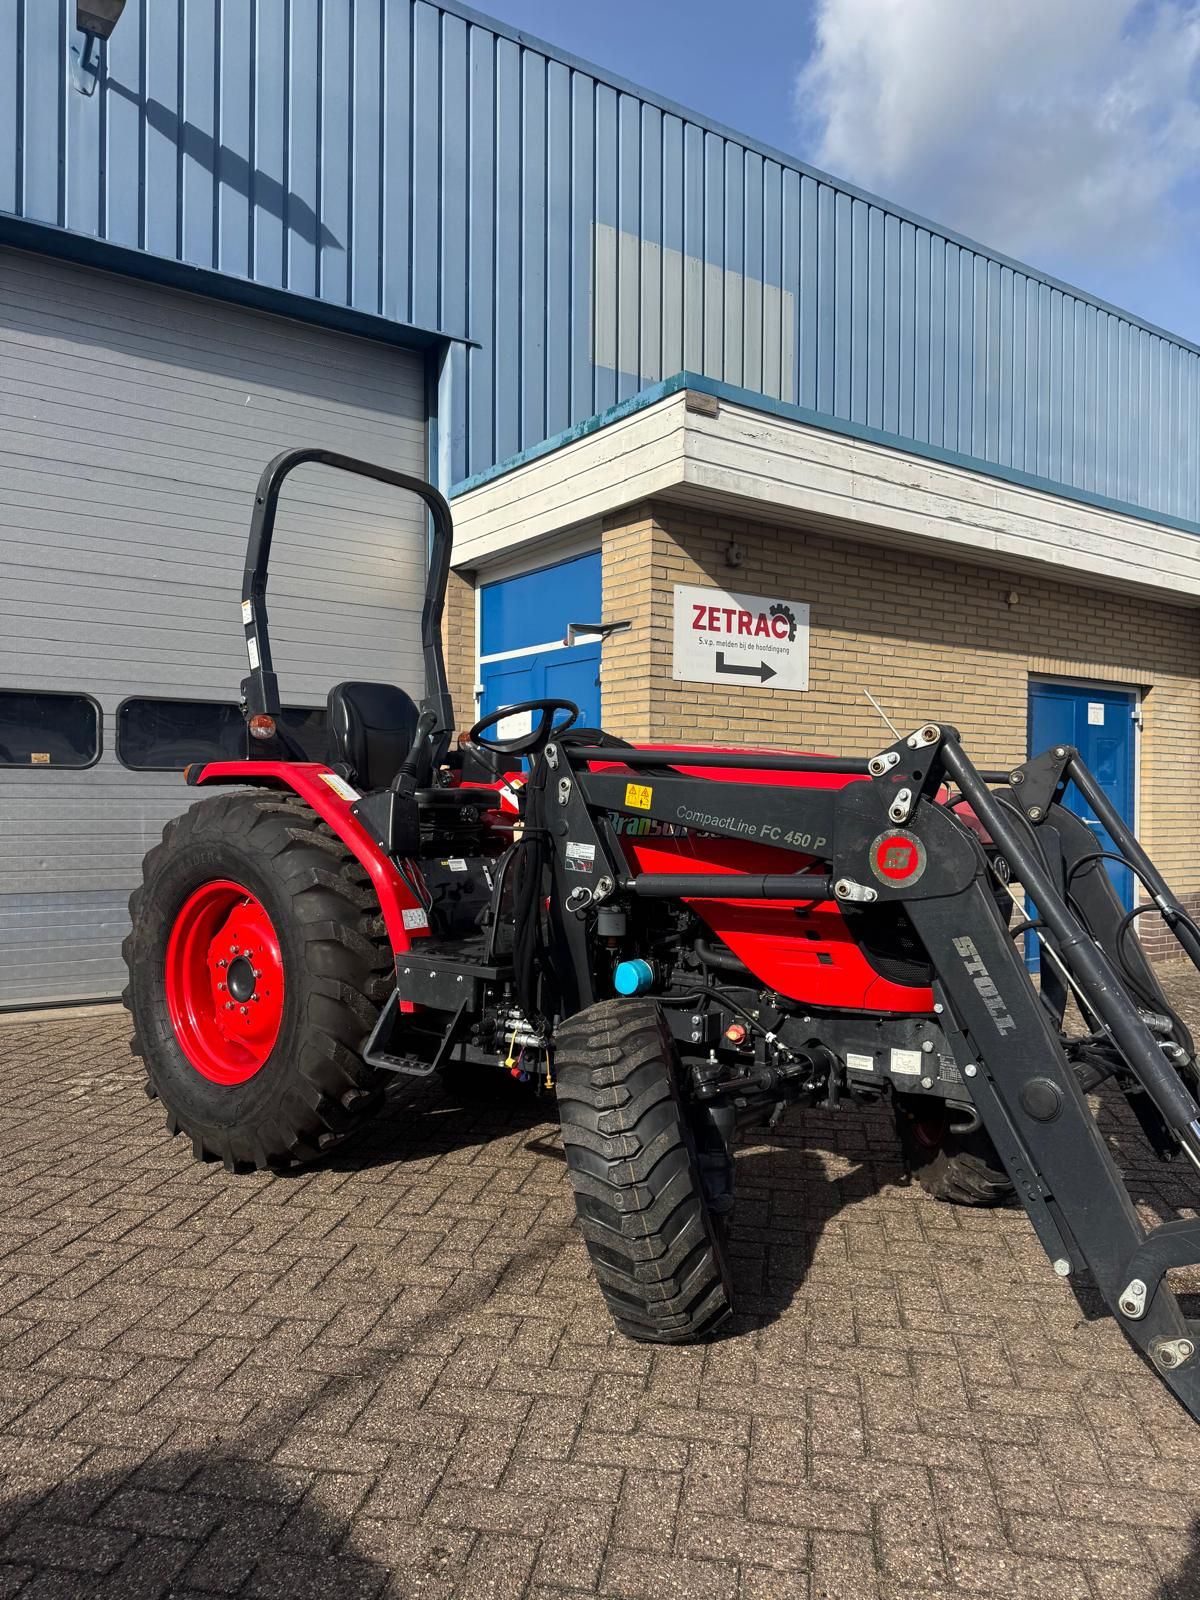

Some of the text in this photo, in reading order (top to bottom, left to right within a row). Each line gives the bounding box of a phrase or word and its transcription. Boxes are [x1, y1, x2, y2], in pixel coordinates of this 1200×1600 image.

[692, 604, 789, 639] ZETRAC
[698, 636, 714, 646] S.v.p.
[715, 640, 738, 648] melden
[739, 642, 747, 650] bij
[755, 644, 790, 655] hoofdingang
[676, 805, 757, 835] CompactLine
[759, 824, 781, 840] FC
[783, 831, 811, 847] 450
[813, 836, 827, 850] P
[952, 936, 1016, 1036] STOLL
